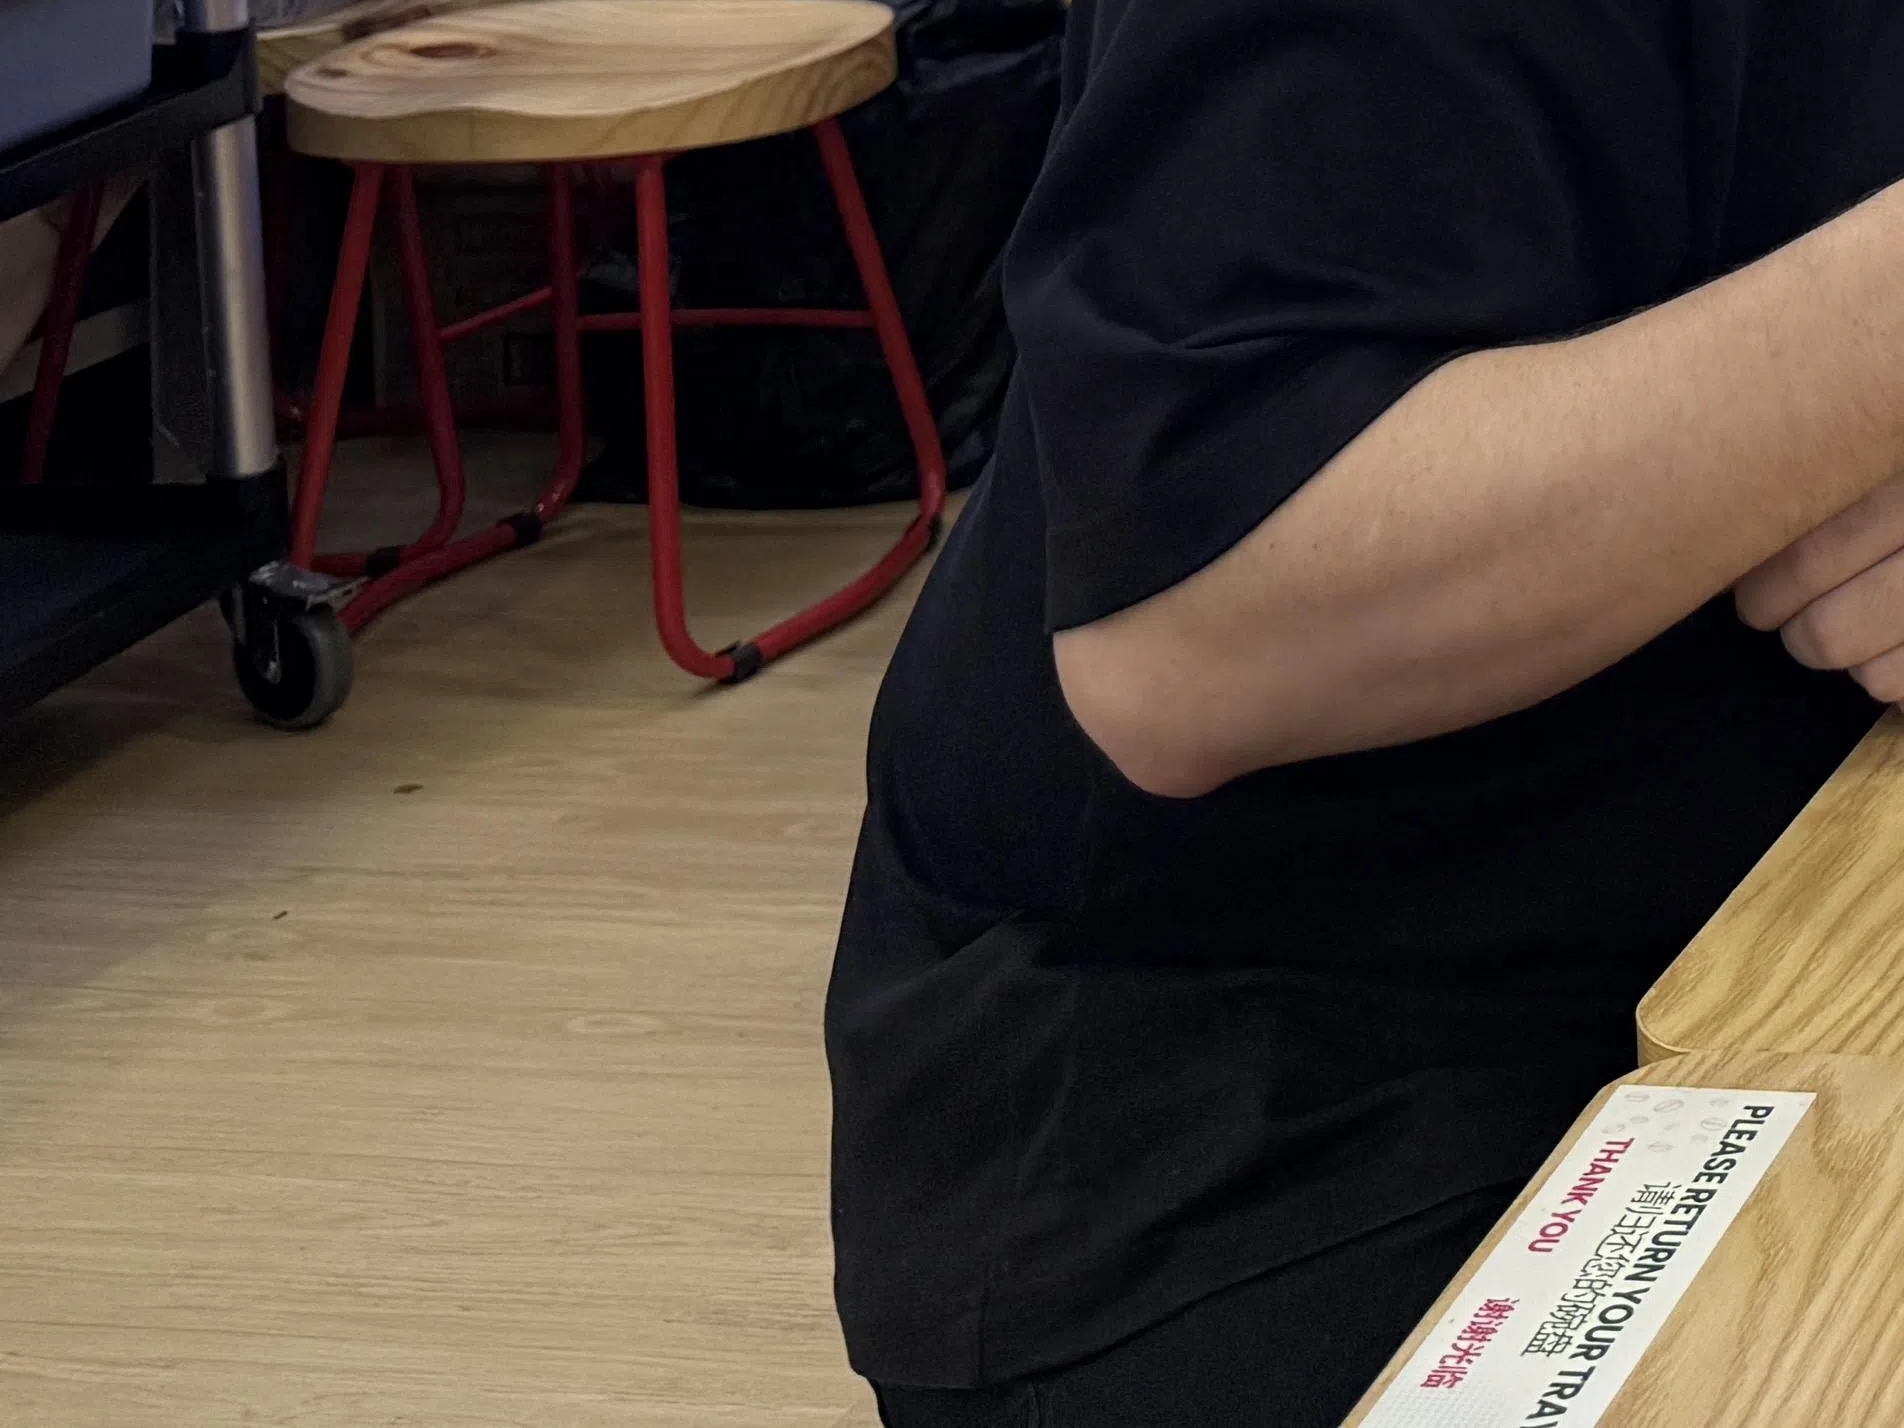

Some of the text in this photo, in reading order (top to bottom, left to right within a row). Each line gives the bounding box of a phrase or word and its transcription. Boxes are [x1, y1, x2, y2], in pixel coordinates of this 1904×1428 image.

[1691, 1104, 1776, 1185] PLEASE
[1527, 1137, 1636, 1254] THANK YOU
[1623, 1187, 1718, 1284] RETURN
[1520, 1180, 1681, 1358] 请归还您的碗盘
[1420, 1296, 1520, 1389] 谢谢光临
[1568, 1286, 1651, 1362] YOUR
